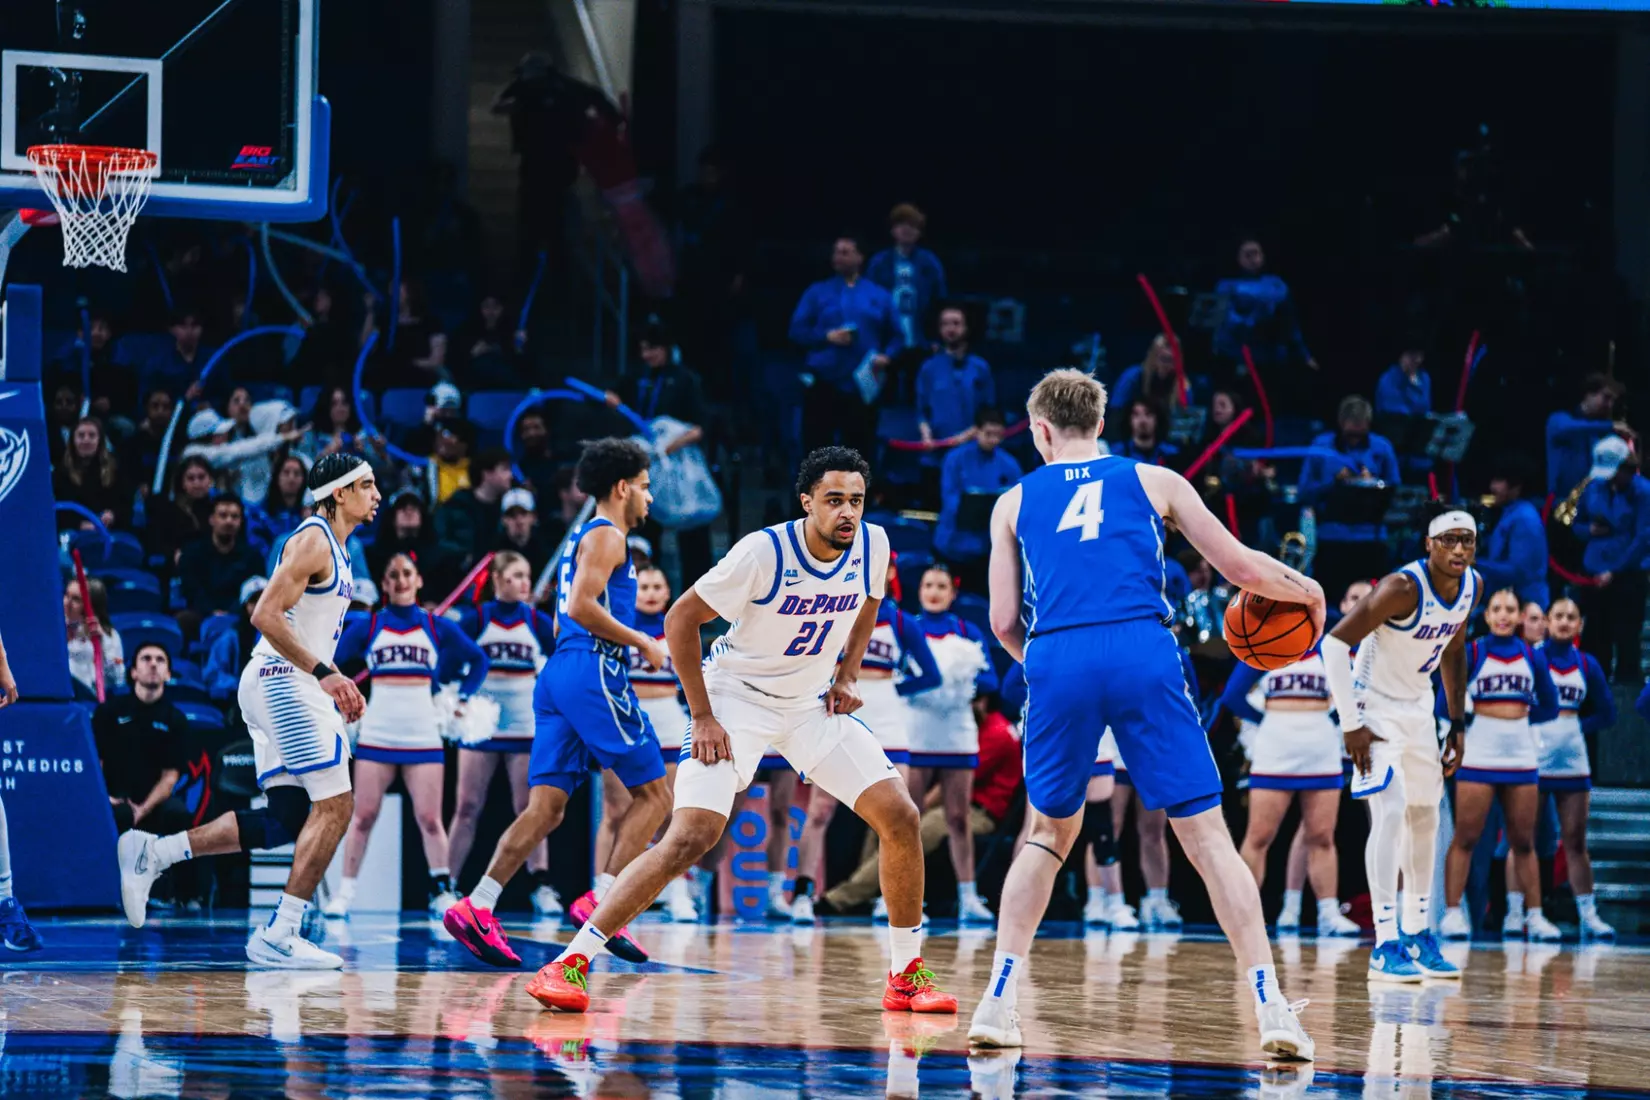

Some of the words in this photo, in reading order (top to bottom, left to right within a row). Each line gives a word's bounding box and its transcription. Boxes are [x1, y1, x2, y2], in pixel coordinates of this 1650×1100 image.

[234, 155, 280, 166] EAST
[240, 145, 272, 157] BIG
[1064, 466, 1092, 482] DIX
[1056, 479, 1104, 542] 4
[777, 593, 859, 615] DEPAUL
[783, 619, 835, 657] 21
[1417, 644, 1443, 673] 2
[259, 666, 295, 677] DEPAUL
